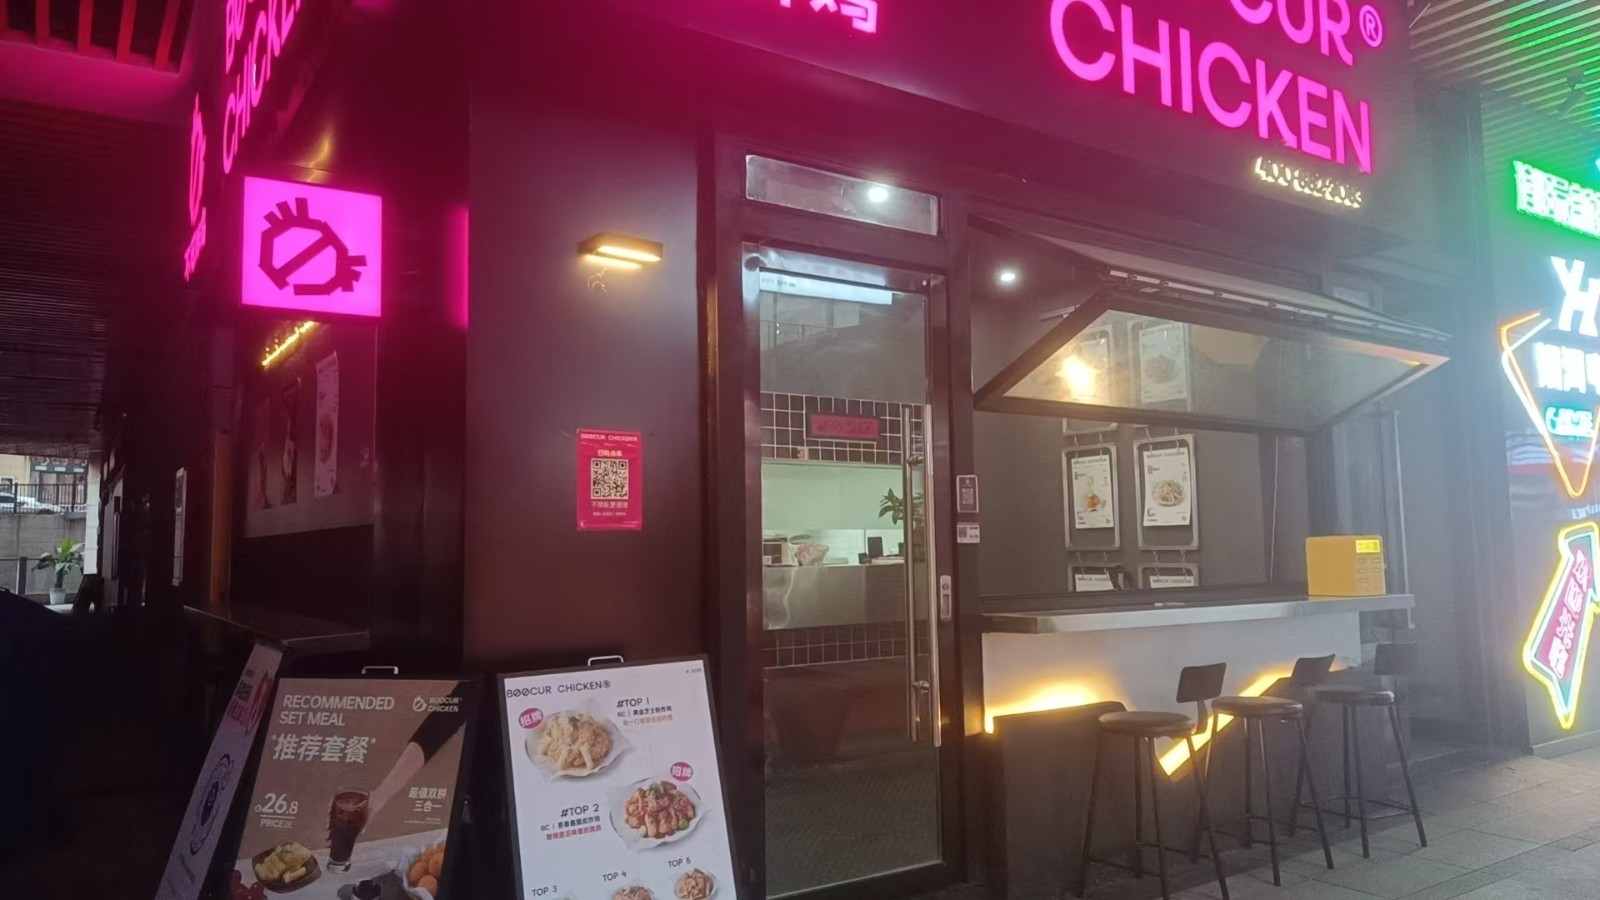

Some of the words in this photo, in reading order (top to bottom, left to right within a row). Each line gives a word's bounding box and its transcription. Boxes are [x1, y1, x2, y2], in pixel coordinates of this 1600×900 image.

[1049, 0, 1372, 175] CHICKEN
[283, 694, 395, 711] RECOMMENDED
[616, 697, 643, 708] #TOP
[427, 705, 459, 713] CHICKEN
[279, 711, 305, 725] SET
[307, 712, 346, 726] MEAL
[413, 800, 442, 812] 三合一
[560, 805, 589, 818] #TOP
[592, 803, 599, 812] 2
[667, 858, 683, 868] TOP
[602, 872, 619, 882] TOP
[531, 887, 549, 897] TOP
